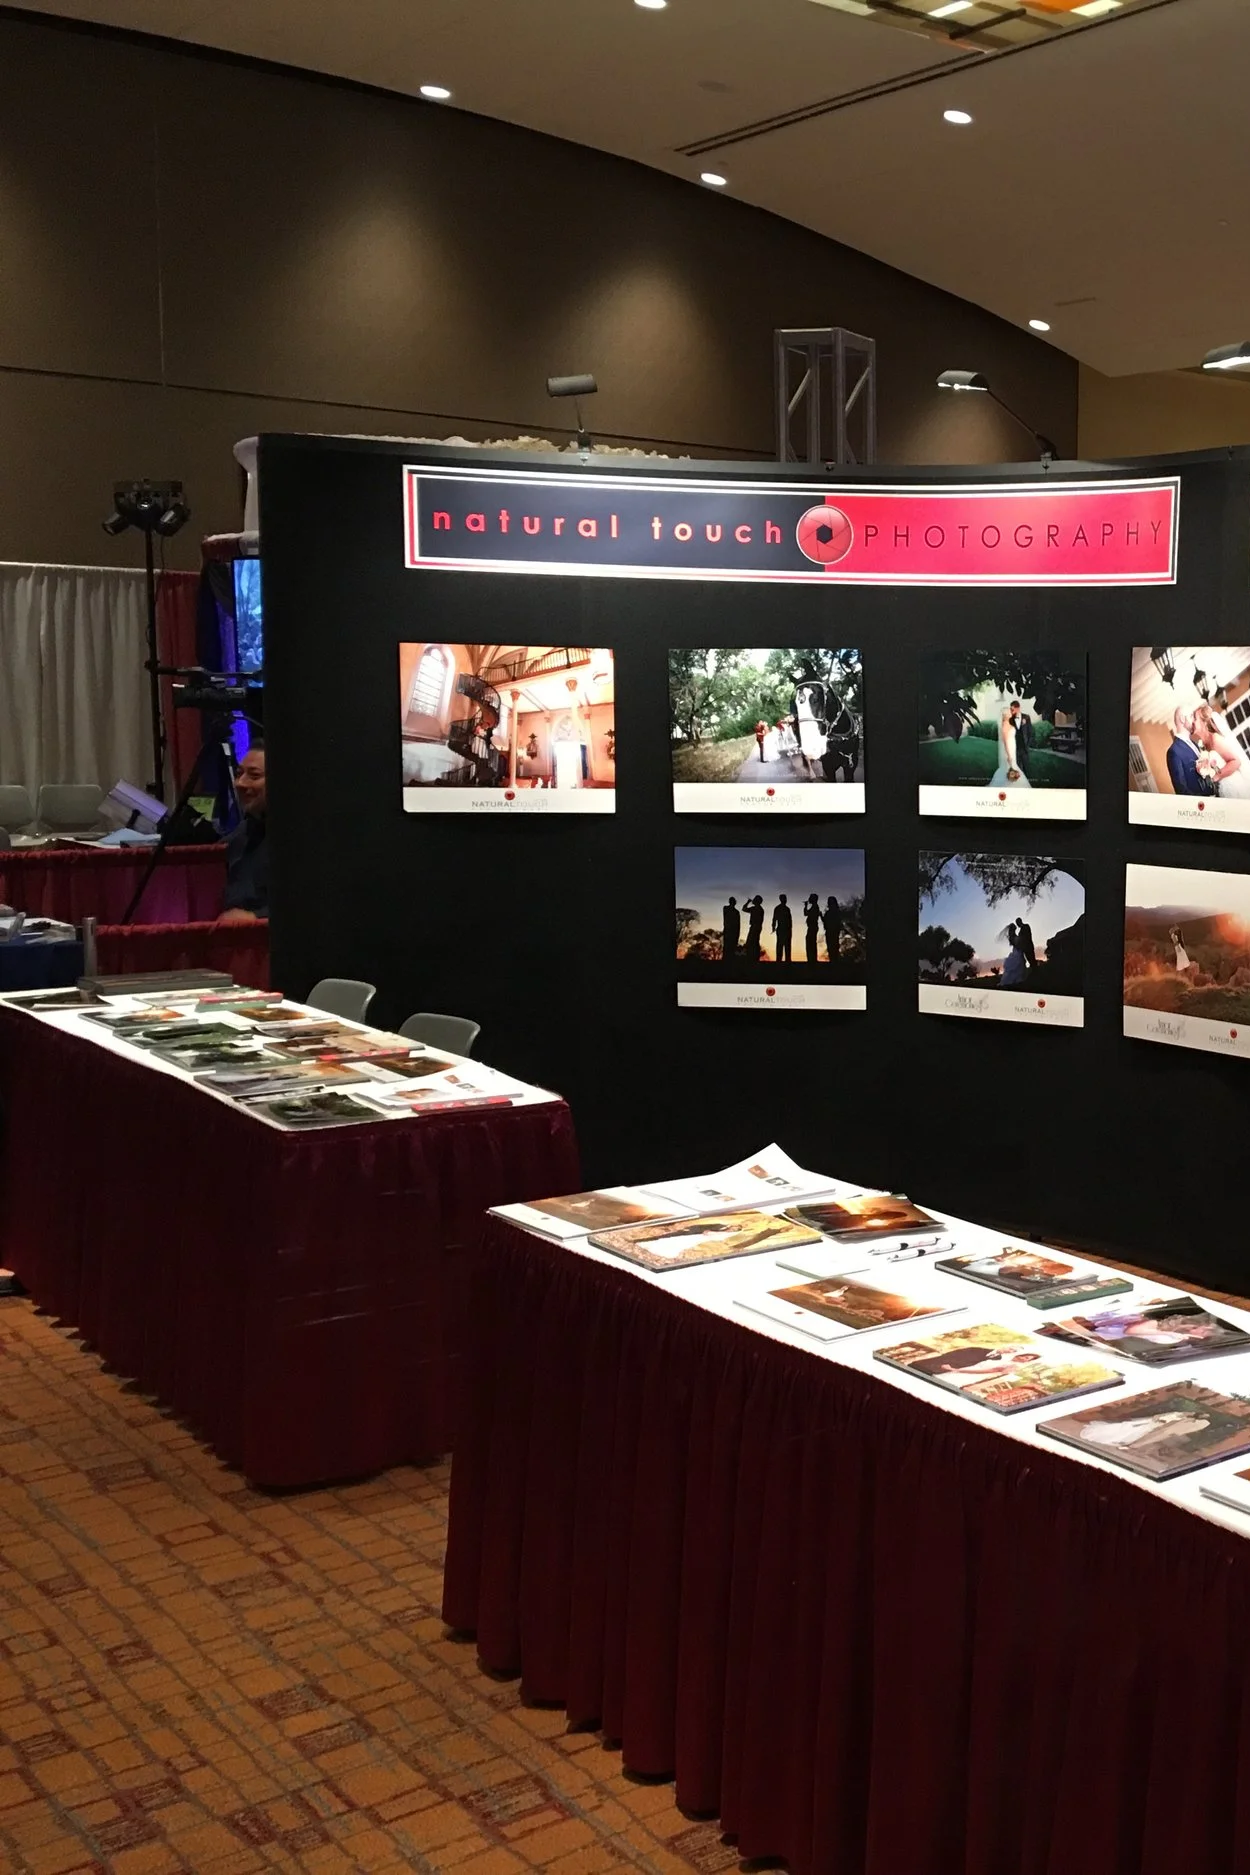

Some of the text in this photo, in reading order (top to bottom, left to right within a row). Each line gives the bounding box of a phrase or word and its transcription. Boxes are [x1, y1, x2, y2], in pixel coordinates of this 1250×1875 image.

[432, 509, 1162, 549] natural touch PHOTOGRAPHY
